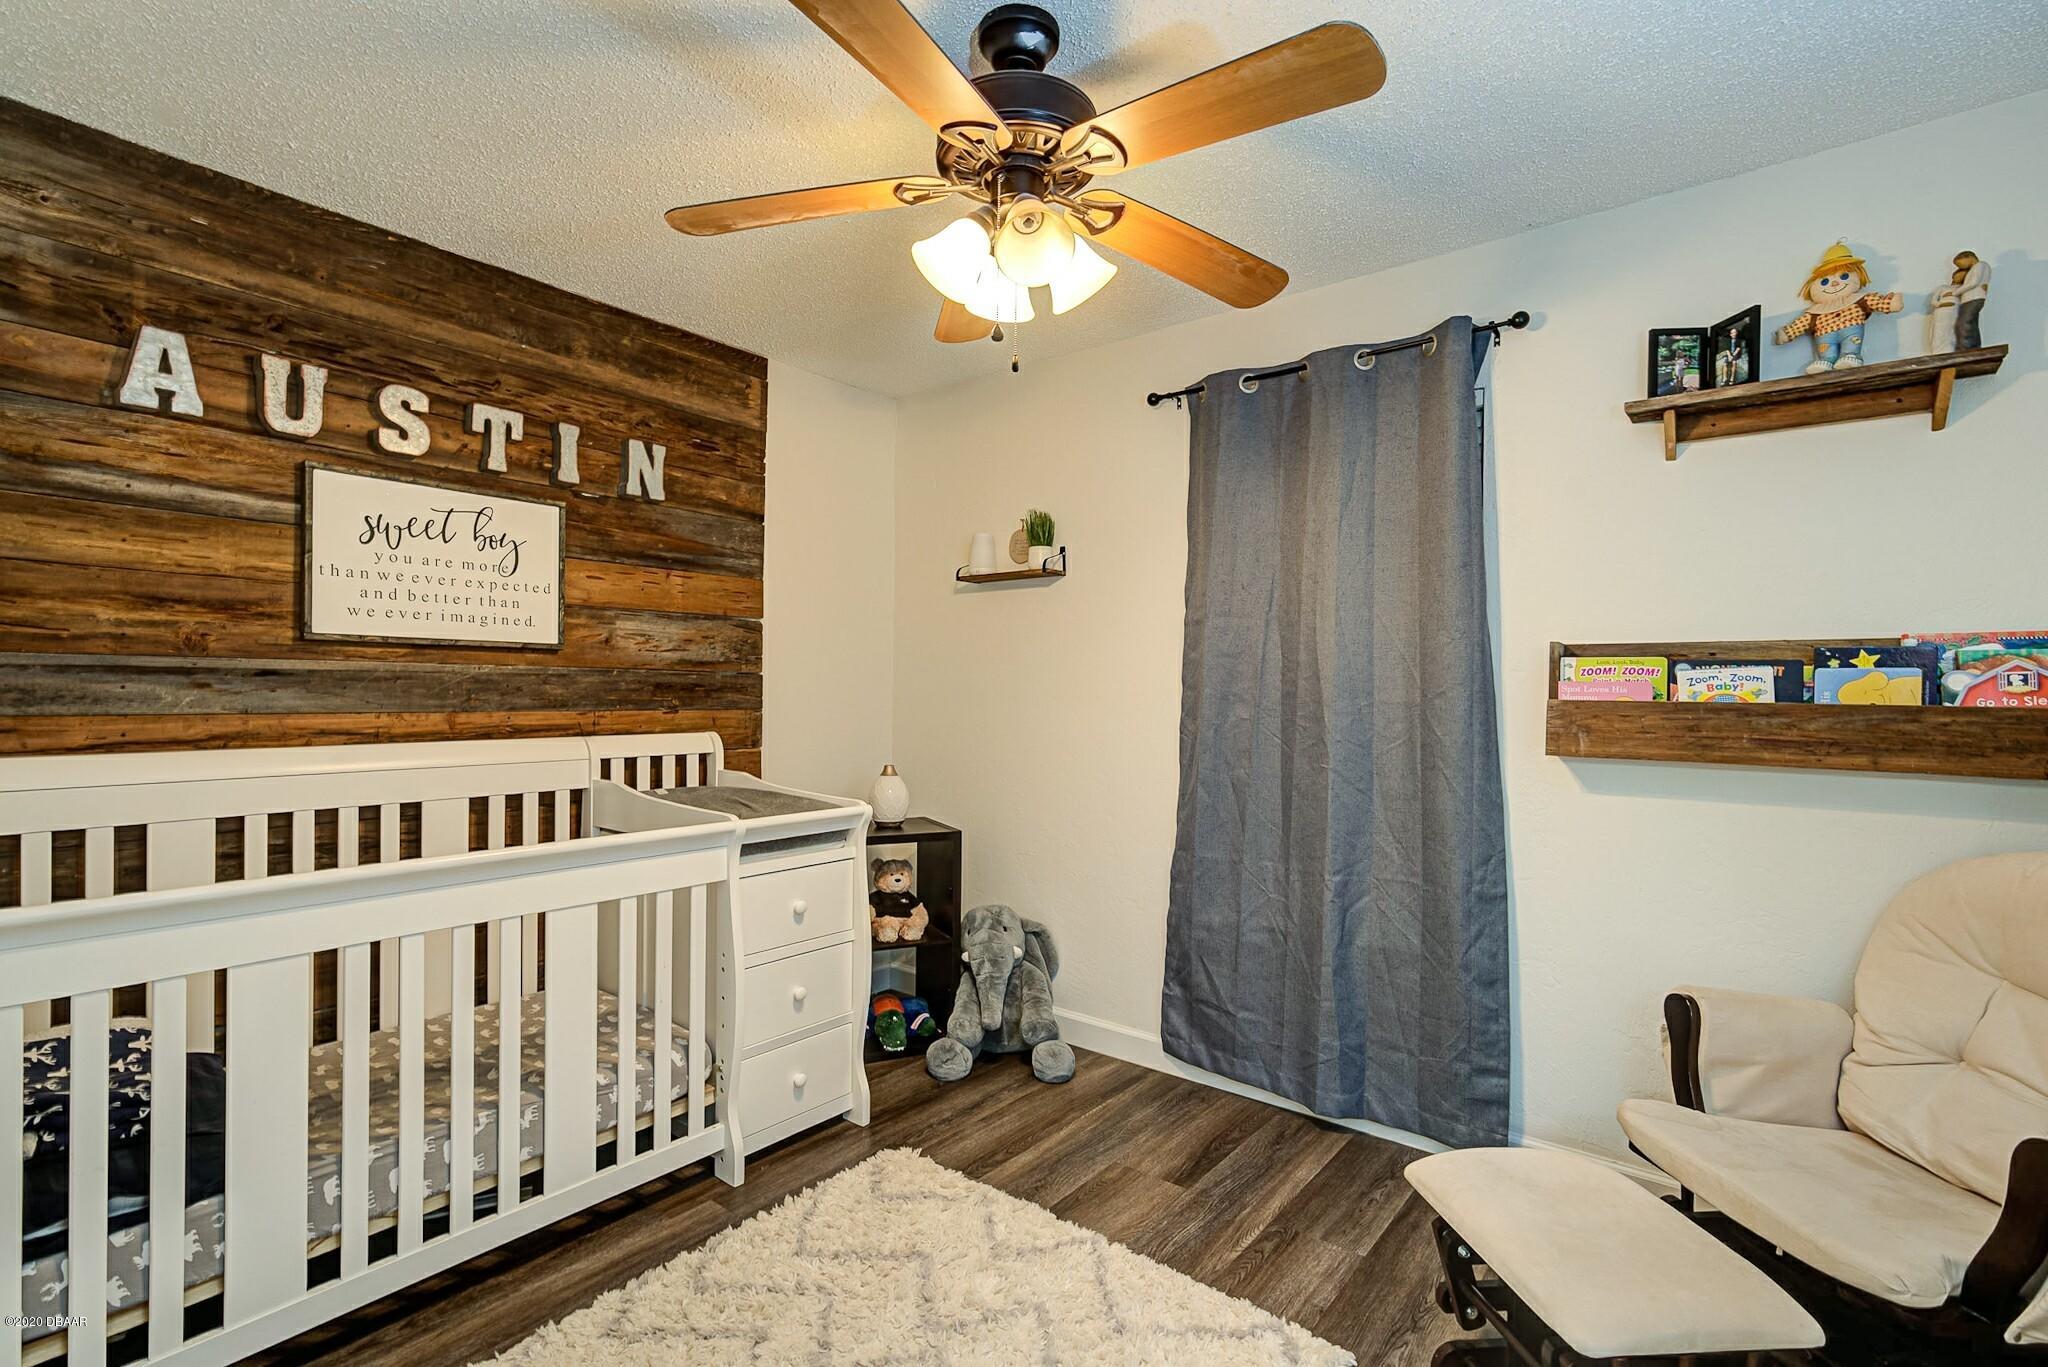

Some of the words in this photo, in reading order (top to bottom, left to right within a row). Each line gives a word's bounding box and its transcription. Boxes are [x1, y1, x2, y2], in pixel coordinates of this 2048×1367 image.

[358, 508, 457, 550] sweet
[473, 506, 528, 578] boy
[374, 552, 412, 565] you
[422, 556, 453, 569] are
[462, 561, 509, 574] more
[319, 563, 370, 580] than
[377, 571, 404, 582] we
[411, 573, 457, 587] ever
[465, 578, 551, 595] expected
[359, 587, 398, 601] and
[407, 588, 471, 606] better
[479, 595, 520, 609] than
[347, 606, 375, 618] we
[385, 608, 432, 621] ever
[441, 608, 536, 627] imagined.
[1580, 667, 1617, 677] ZOOM!
[1622, 667, 1661, 677] ZOOM!
[1561, 684, 1581, 695] Spot
[1584, 685, 1610, 693] Loves
[1612, 685, 1628, 694] His
[1976, 697, 1995, 707] Go
[2001, 696, 2018, 707] to
